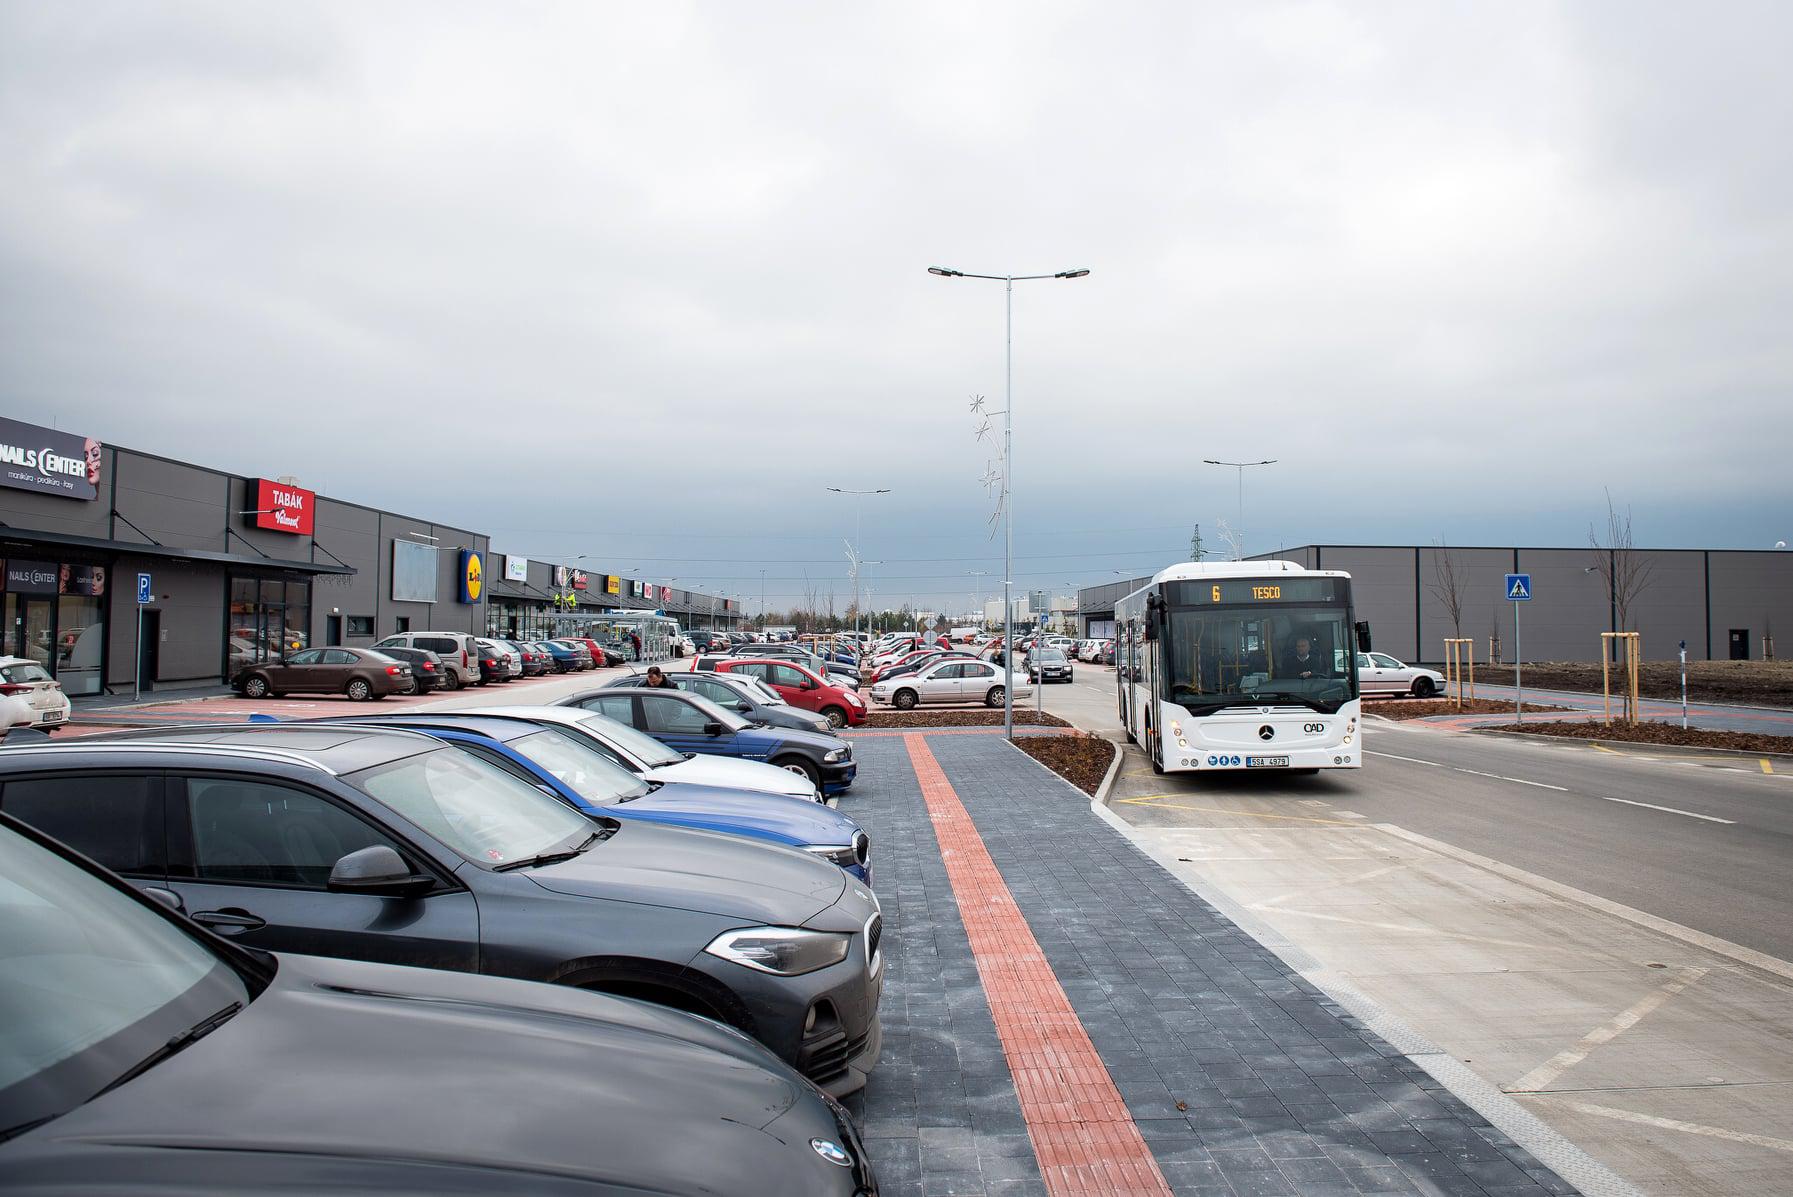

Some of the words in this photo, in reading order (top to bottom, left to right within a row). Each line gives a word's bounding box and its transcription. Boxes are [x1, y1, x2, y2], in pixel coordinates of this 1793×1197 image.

[0, 443, 37, 468] NAILS
[272, 489, 303, 510] TABÁK
[9, 570, 29, 582] NAILS
[140, 577, 148, 594] P
[1212, 585, 1221, 602] 6
[1252, 586, 1281, 600] TESCO
